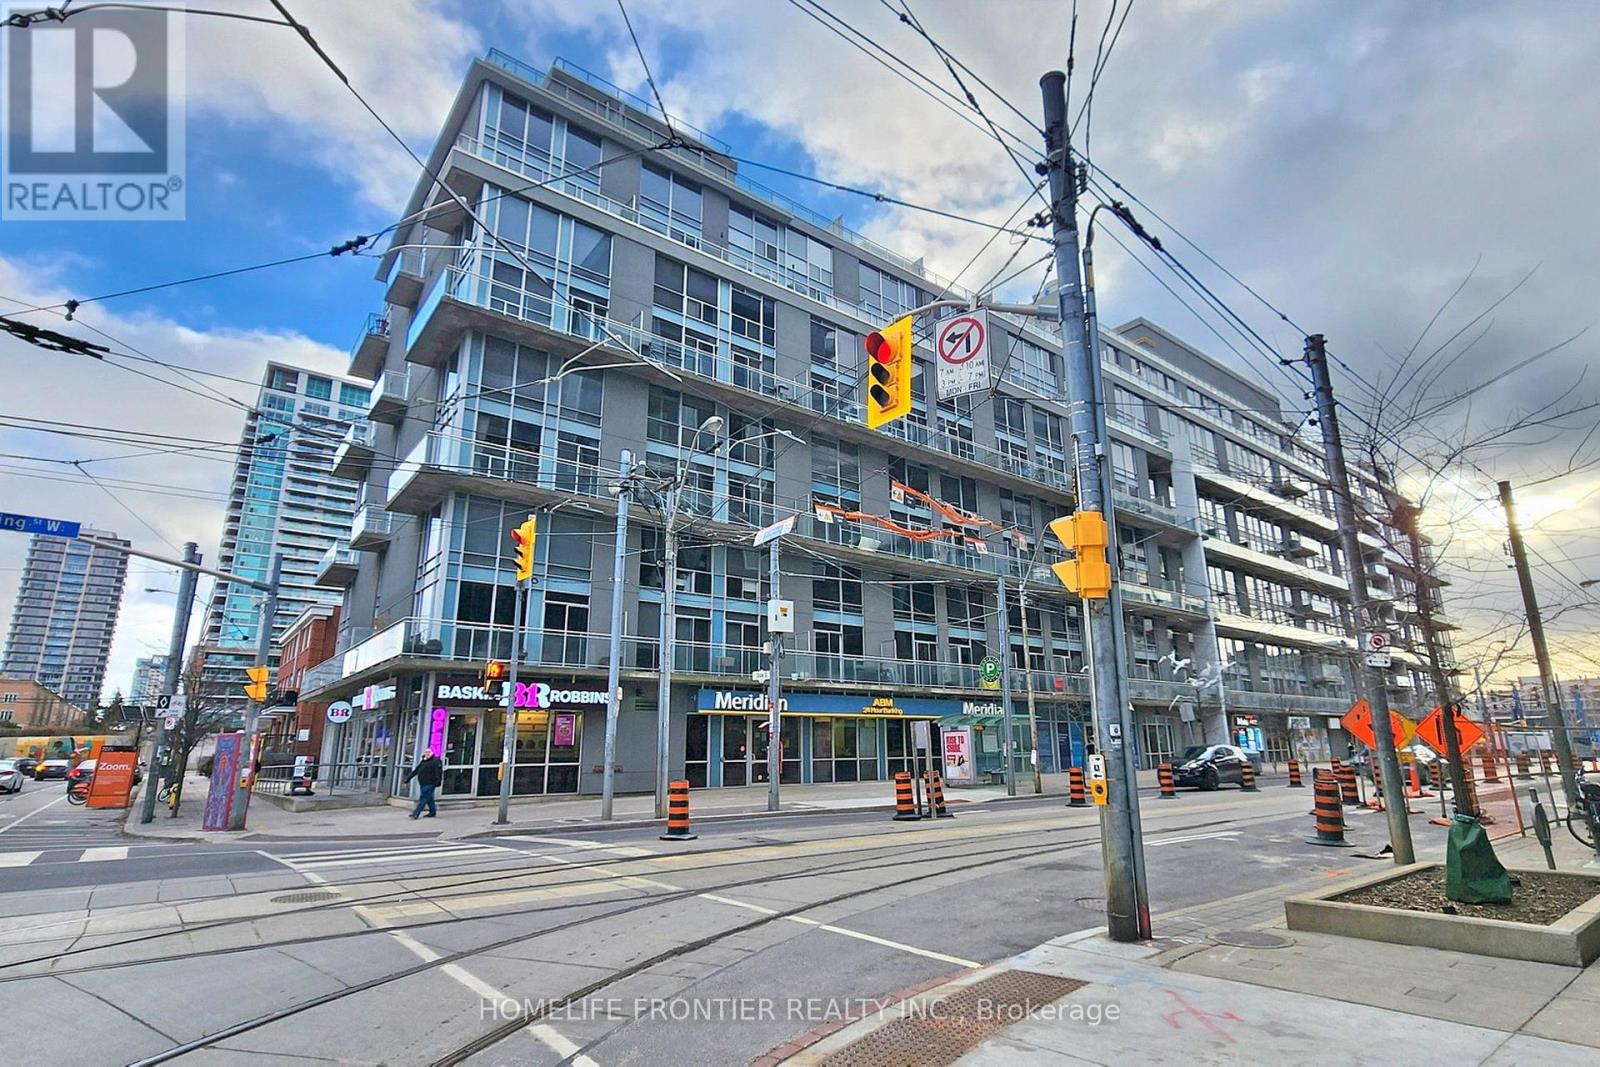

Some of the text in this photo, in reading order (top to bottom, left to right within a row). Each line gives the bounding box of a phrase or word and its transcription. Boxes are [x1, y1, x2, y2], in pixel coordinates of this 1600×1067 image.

[966, 361, 974, 370] 10
[946, 386, 963, 396] MON
[969, 381, 981, 390] FRI
[0, 513, 26, 531] ing
[47, 520, 61, 532] W
[986, 662, 996, 674] P
[437, 685, 501, 700] BASK
[549, 688, 610, 705] ROBBINS
[714, 691, 788, 711] Meridin
[872, 698, 894, 707] ABM
[963, 701, 1004, 715] Meridia
[330, 708, 350, 717] BR
